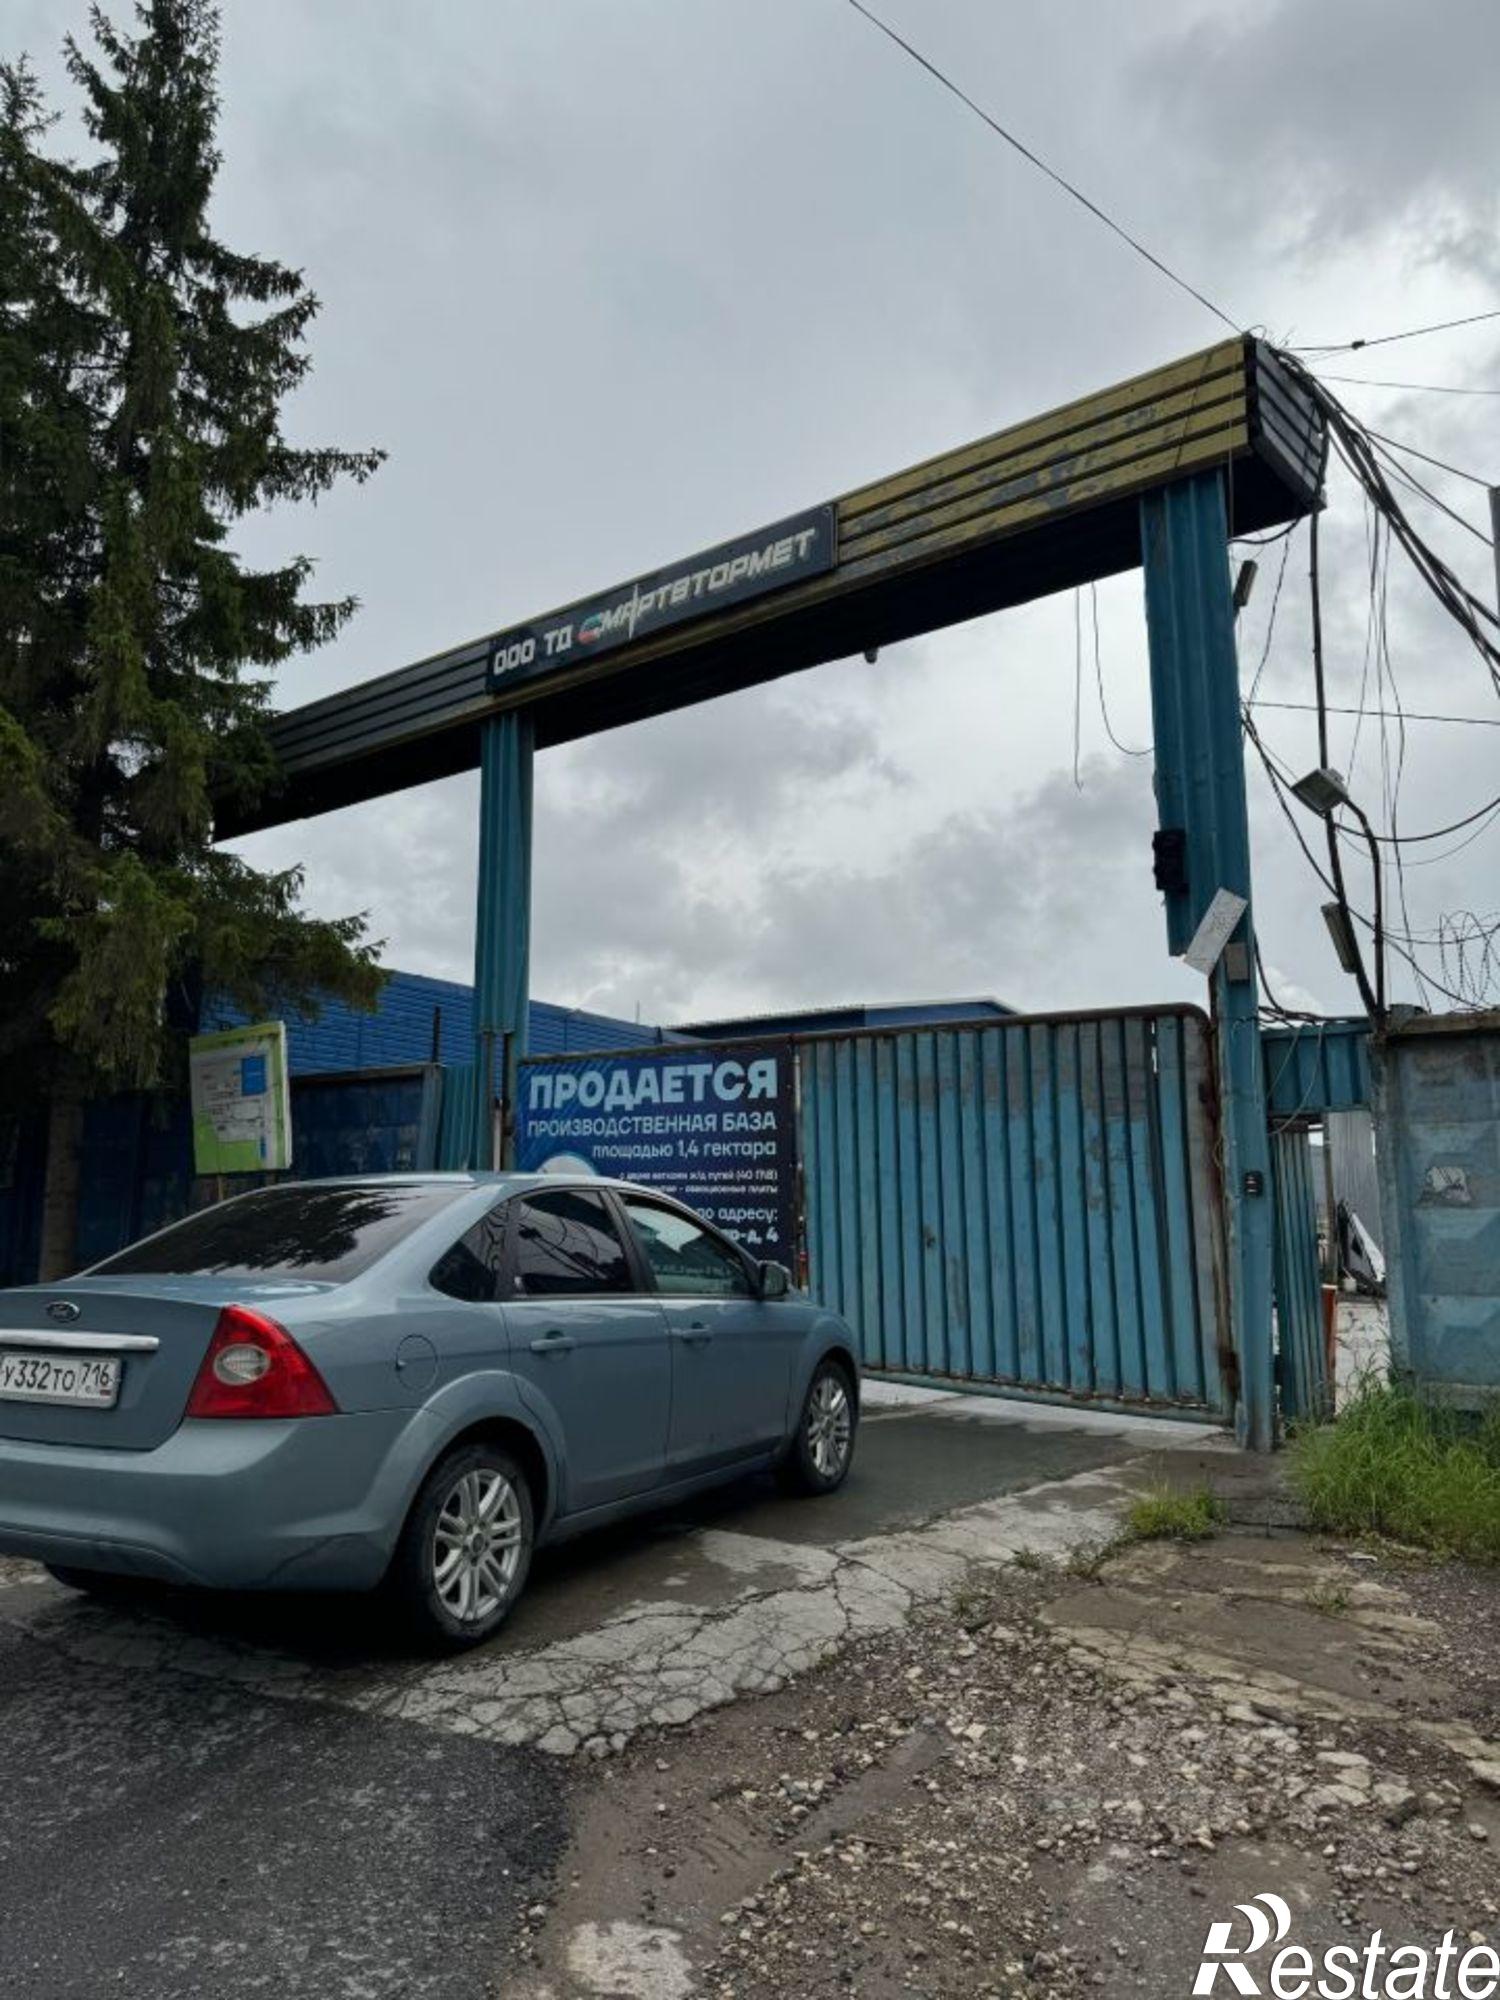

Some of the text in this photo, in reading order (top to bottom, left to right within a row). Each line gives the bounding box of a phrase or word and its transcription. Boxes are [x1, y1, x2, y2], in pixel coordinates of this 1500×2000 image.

[493, 637, 537, 677] ООО
[528, 1057, 778, 1112] ПРОДАЕТСЯ
[526, 1111, 777, 1138] ПРОИЗВОДСТВЕННАЯ БАЗА
[592, 1139, 777, 1160] площадью 1,4 гектара
[718, 1207, 779, 1223] адресу:
[766, 1226, 779, 1243] 4
[81, 1362, 110, 1387] 716
